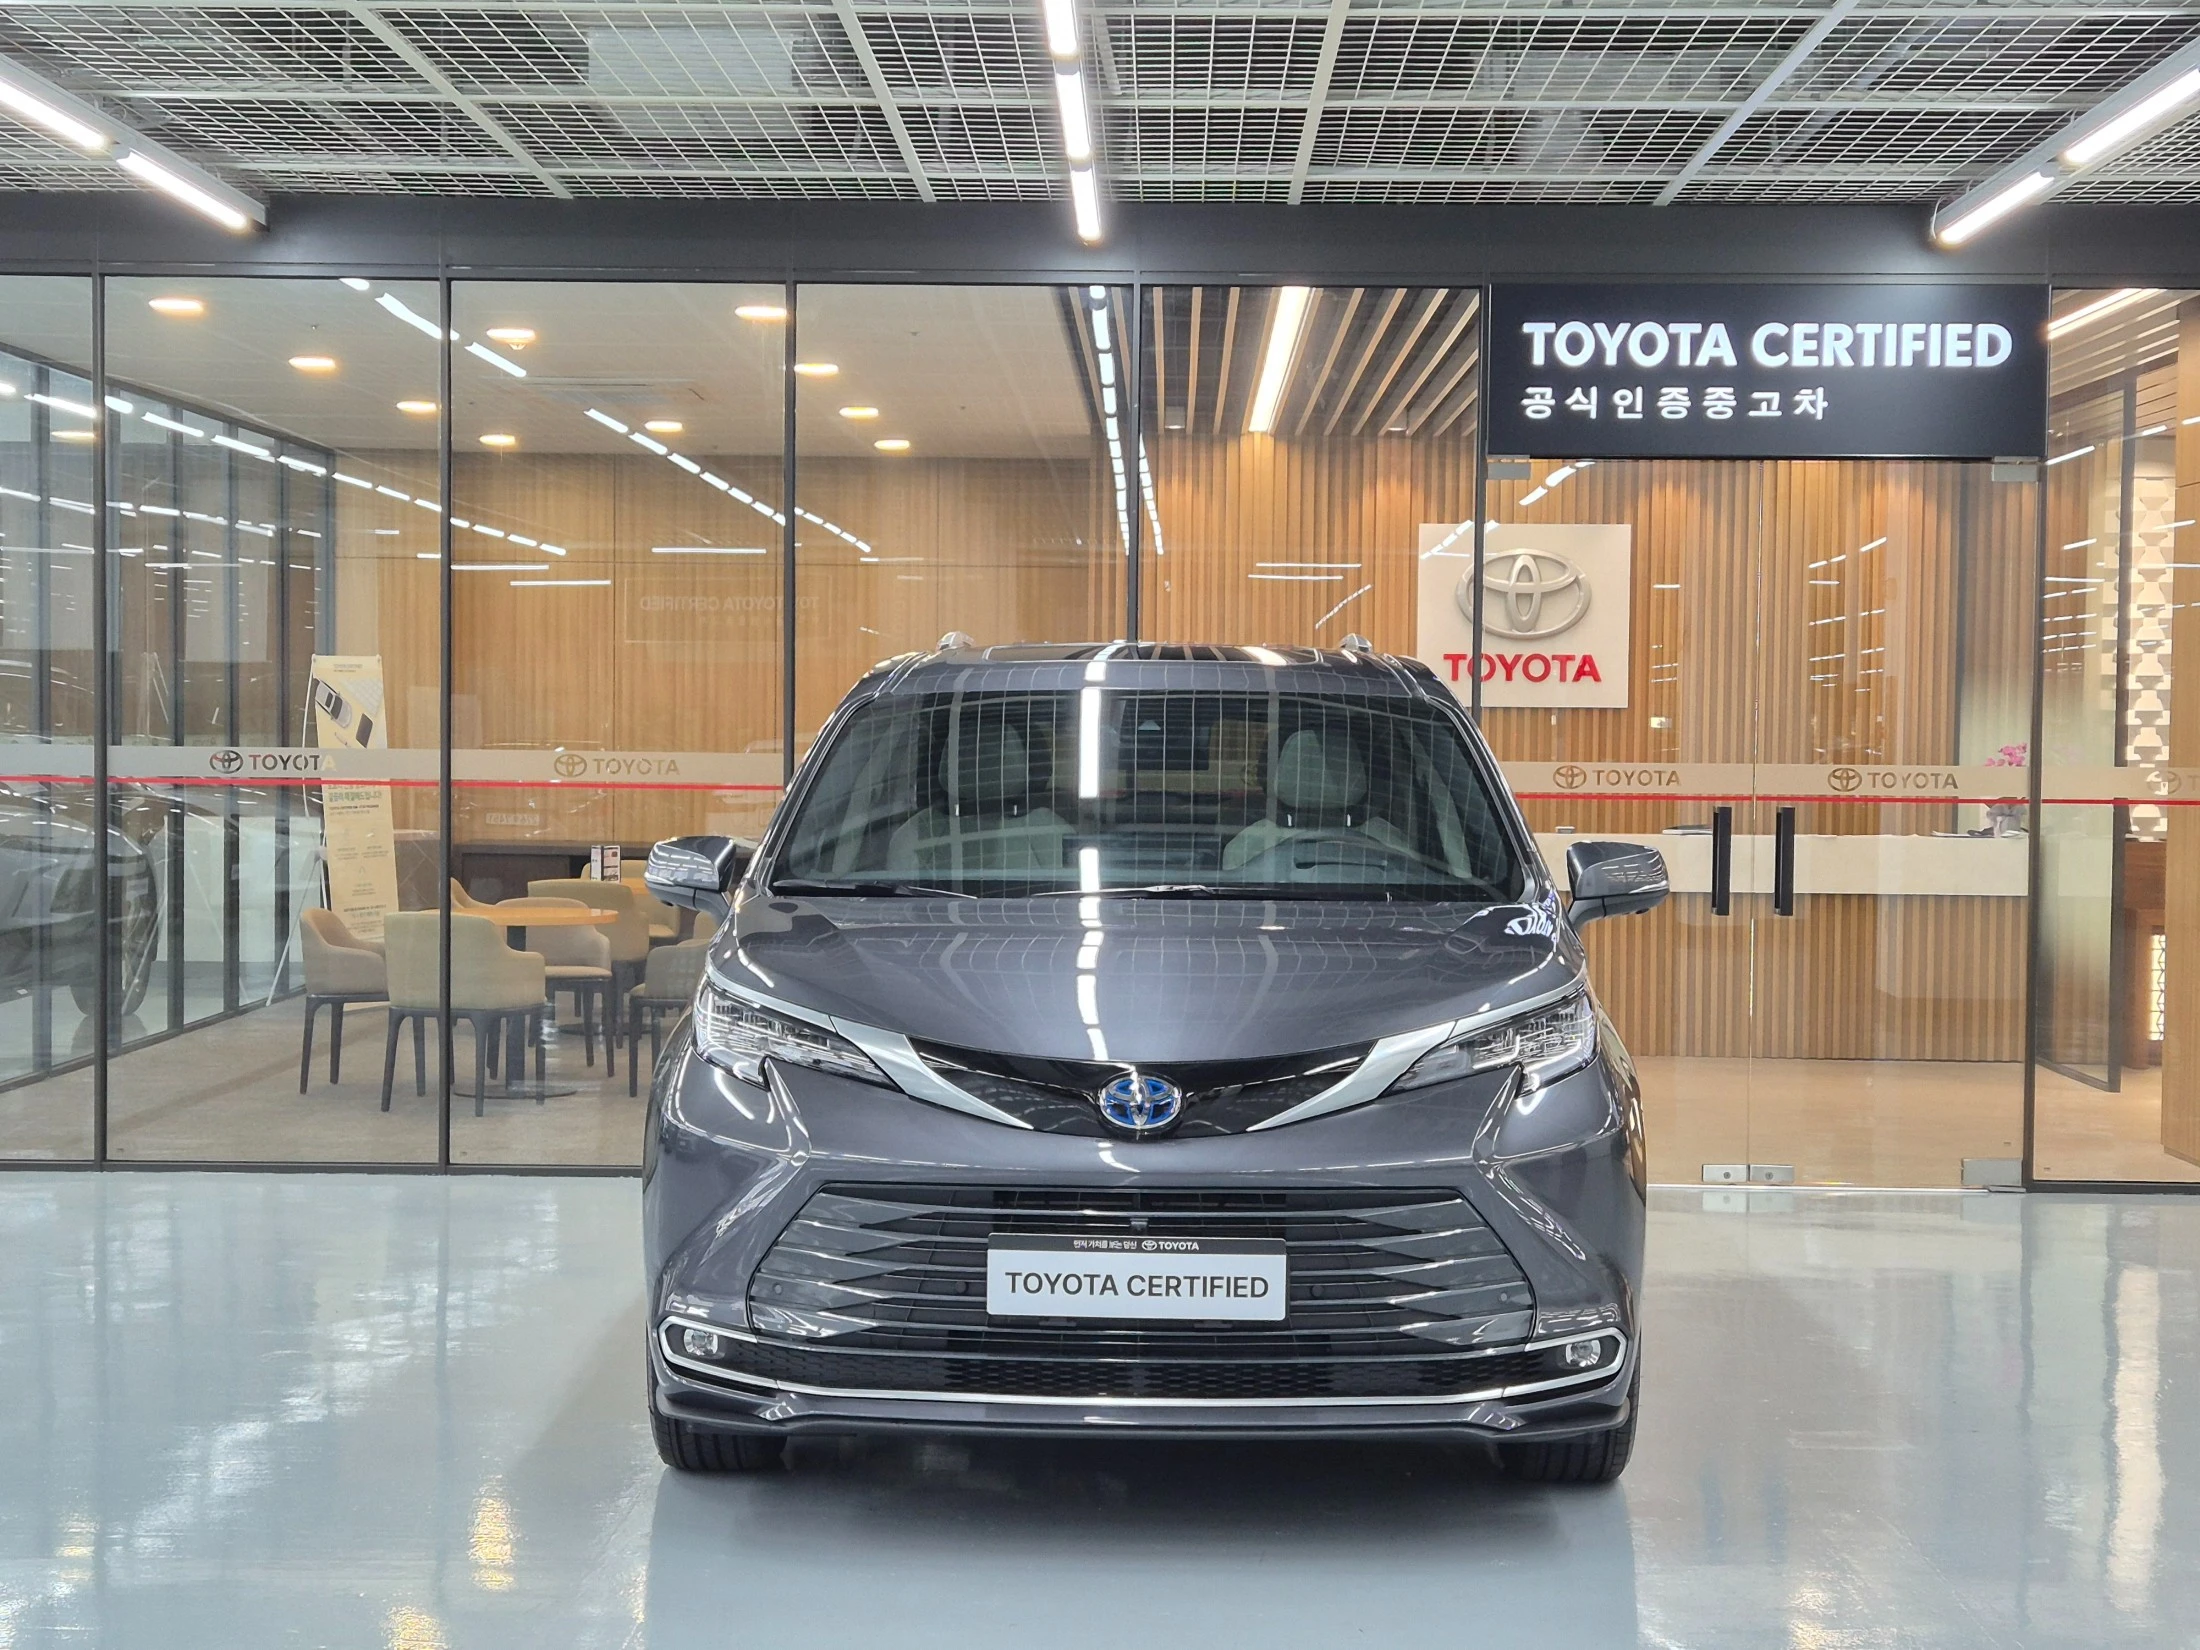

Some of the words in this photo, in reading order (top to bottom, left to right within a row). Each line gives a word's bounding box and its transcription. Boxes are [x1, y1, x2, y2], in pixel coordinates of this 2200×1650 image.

[1522, 321, 1738, 367] TOYOTA
[1751, 322, 2013, 368] CERTIFIED
[1443, 653, 1602, 683] TOYOTA
[248, 754, 337, 771] TOYOTA
[592, 758, 681, 775] TOYOTA
[1592, 769, 1681, 787] TOYOTA
[1867, 772, 1959, 789] TOYOTA
[1159, 1241, 1200, 1250] TOYOTA
[1005, 1272, 1119, 1296] TOYOTA
[1127, 1274, 1269, 1298] CERTIFIED
